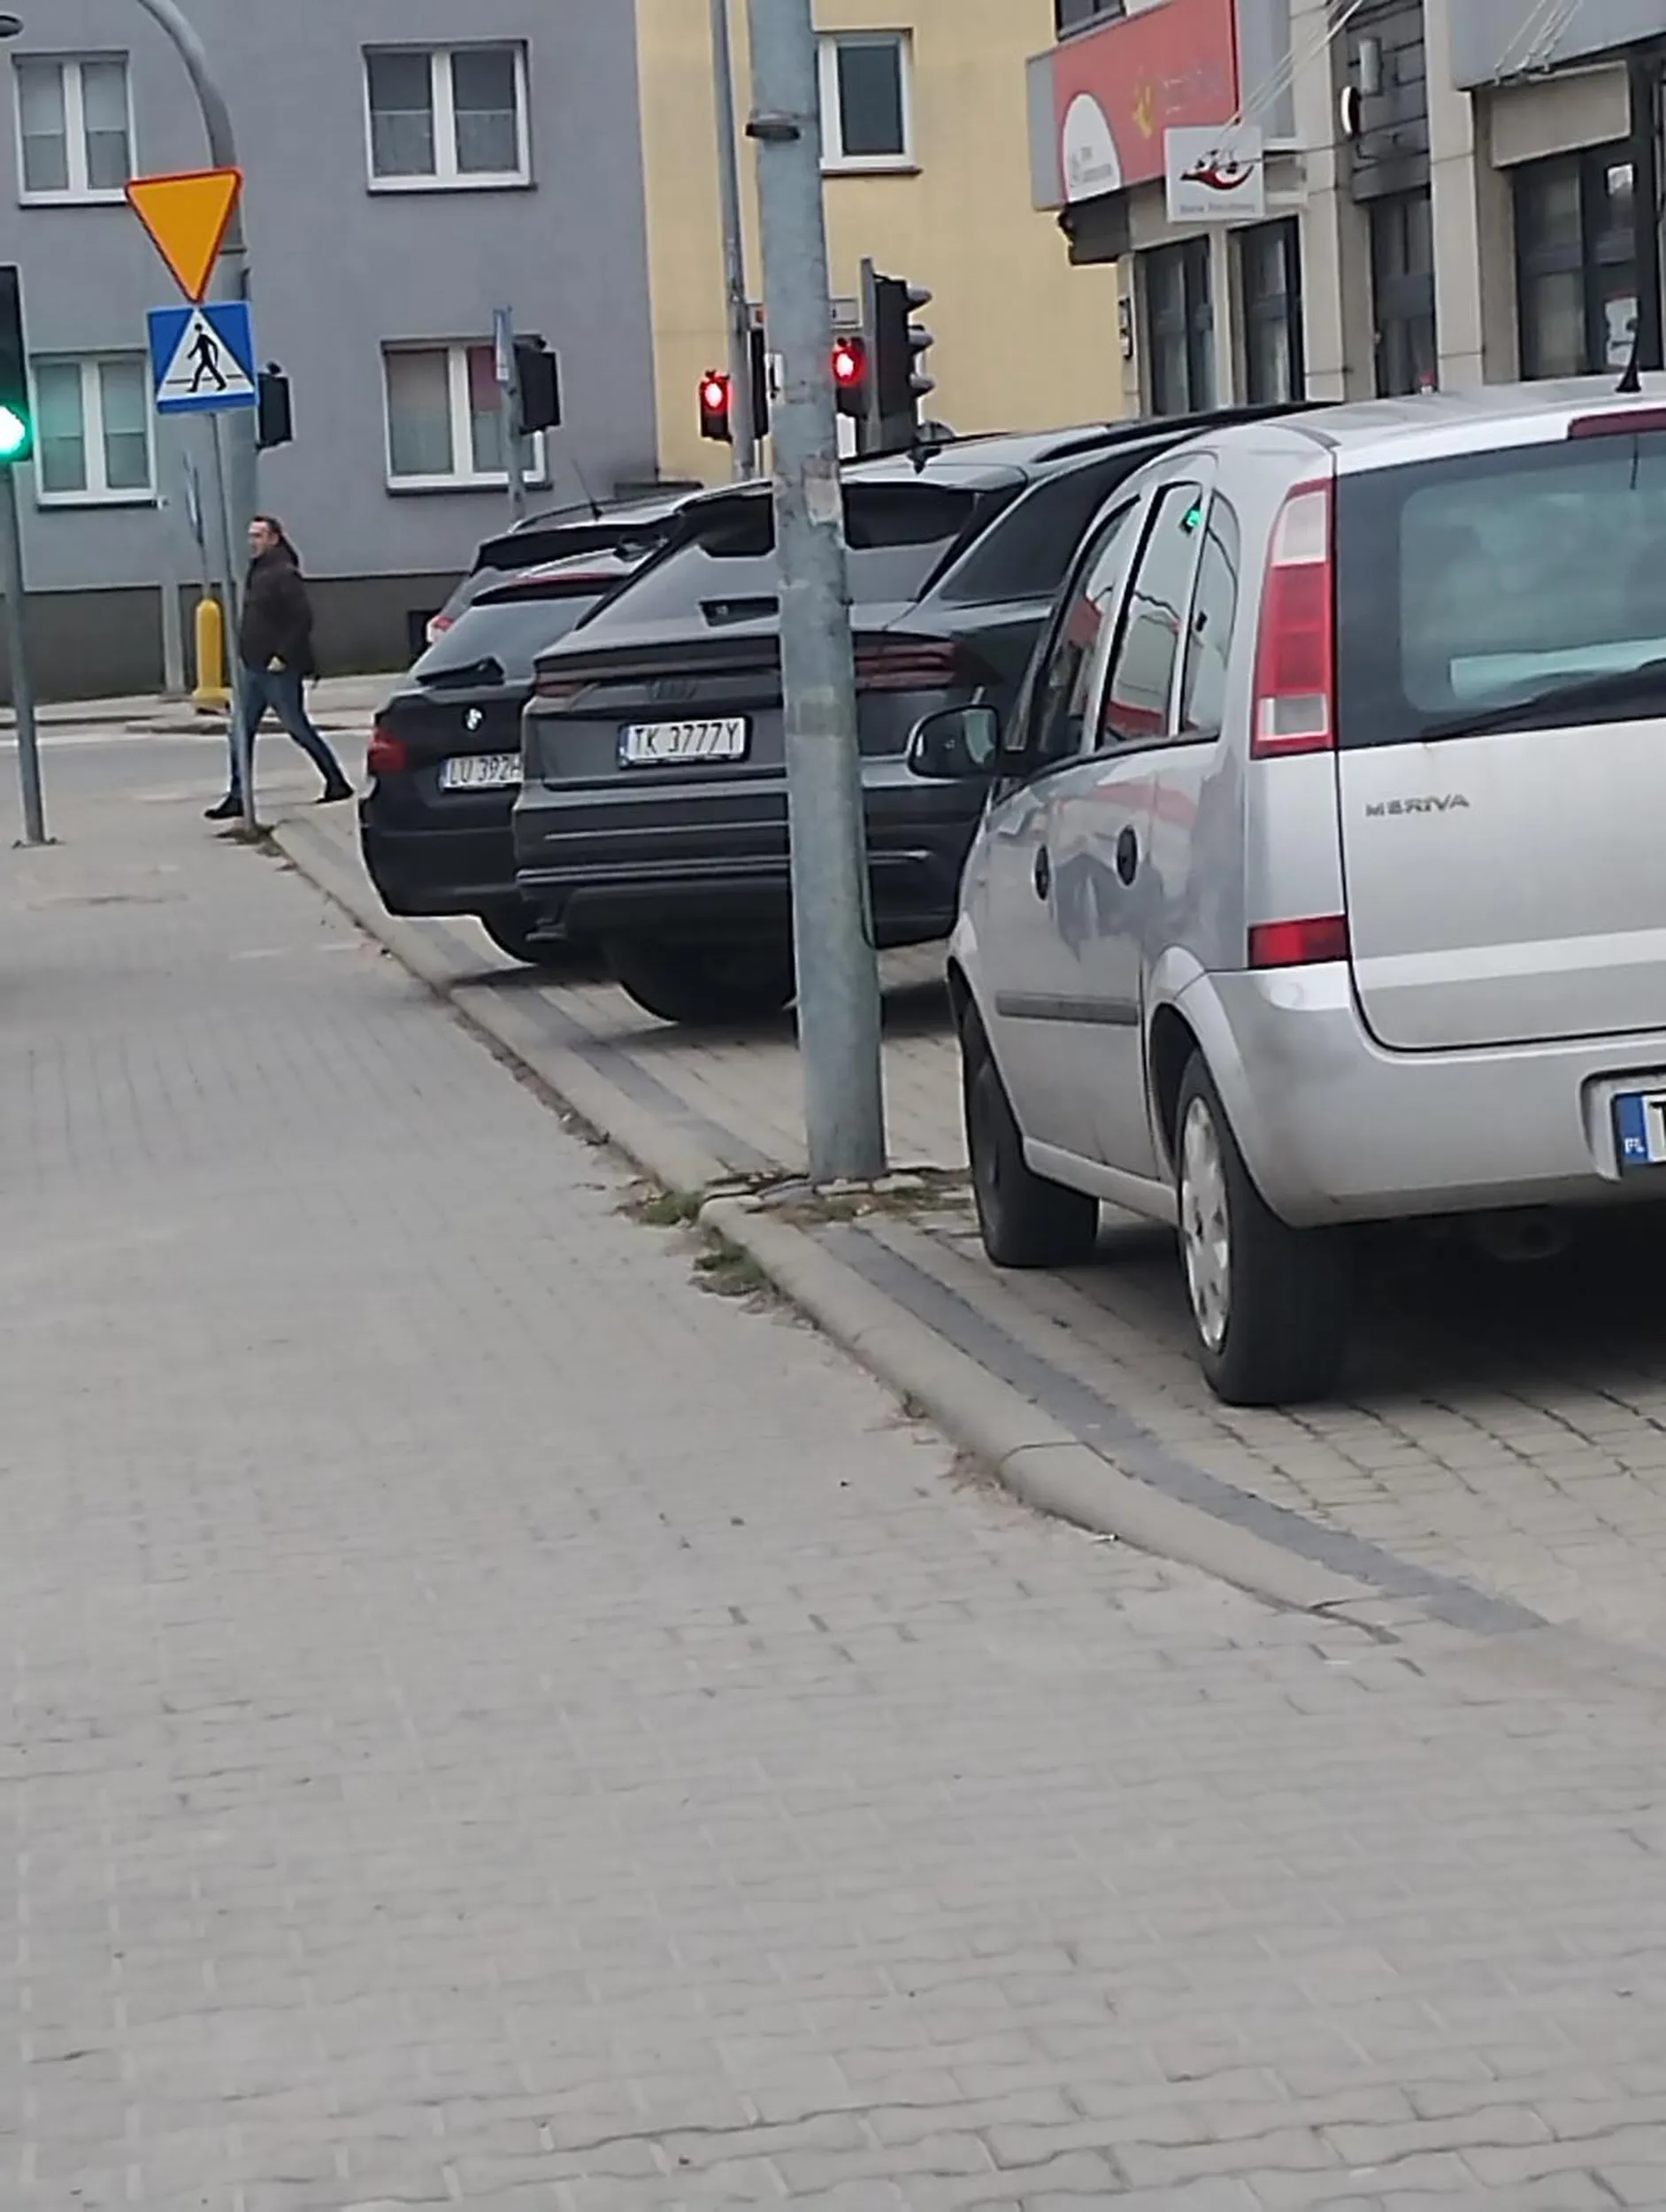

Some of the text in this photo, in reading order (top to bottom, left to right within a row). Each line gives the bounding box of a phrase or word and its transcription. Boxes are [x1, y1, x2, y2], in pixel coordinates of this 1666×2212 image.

[634, 721, 739, 756] TK 3777Y
[450, 757, 472, 785] LU
[1365, 793, 1470, 817] MERIVA
